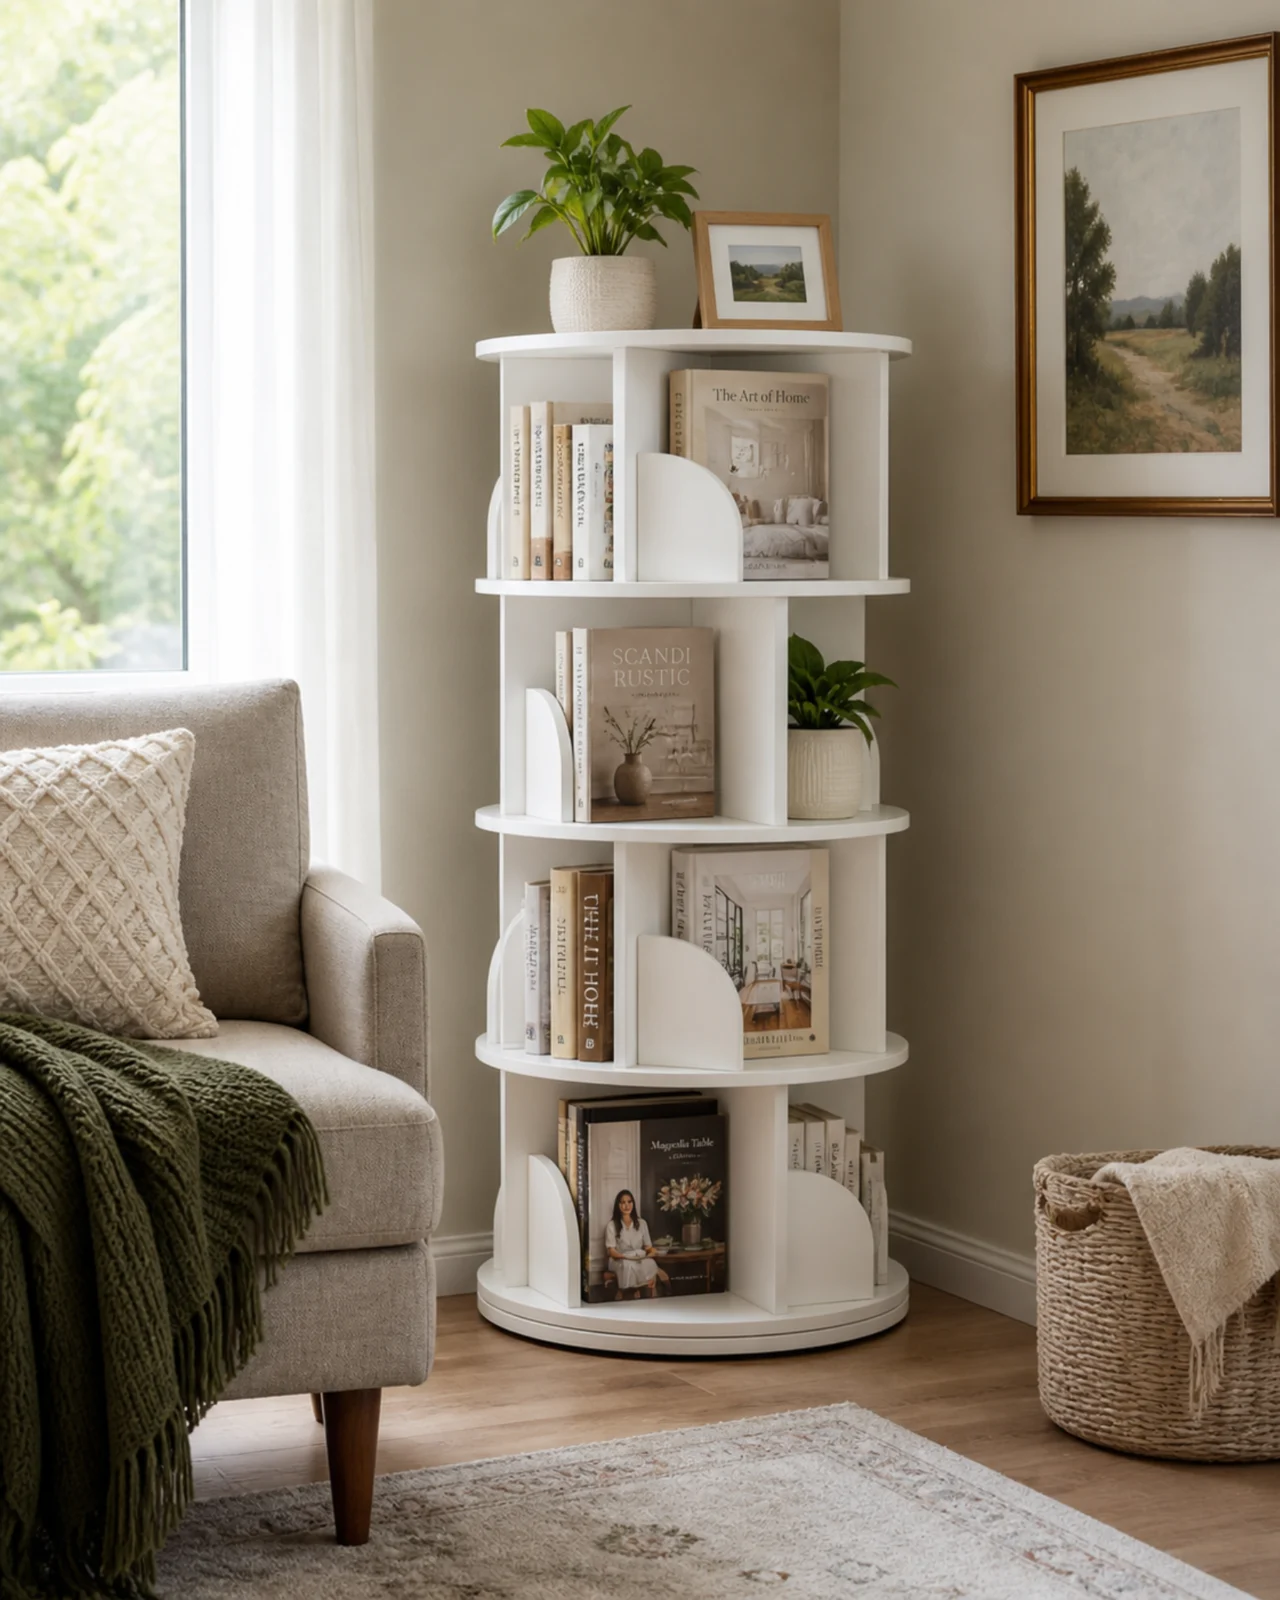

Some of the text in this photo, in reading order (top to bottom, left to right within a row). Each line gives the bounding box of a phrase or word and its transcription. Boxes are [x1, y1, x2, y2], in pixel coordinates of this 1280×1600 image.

[712, 388, 810, 404] The Art of Home
[612, 648, 691, 665] SCANDI
[614, 669, 690, 687] RUSTIC
